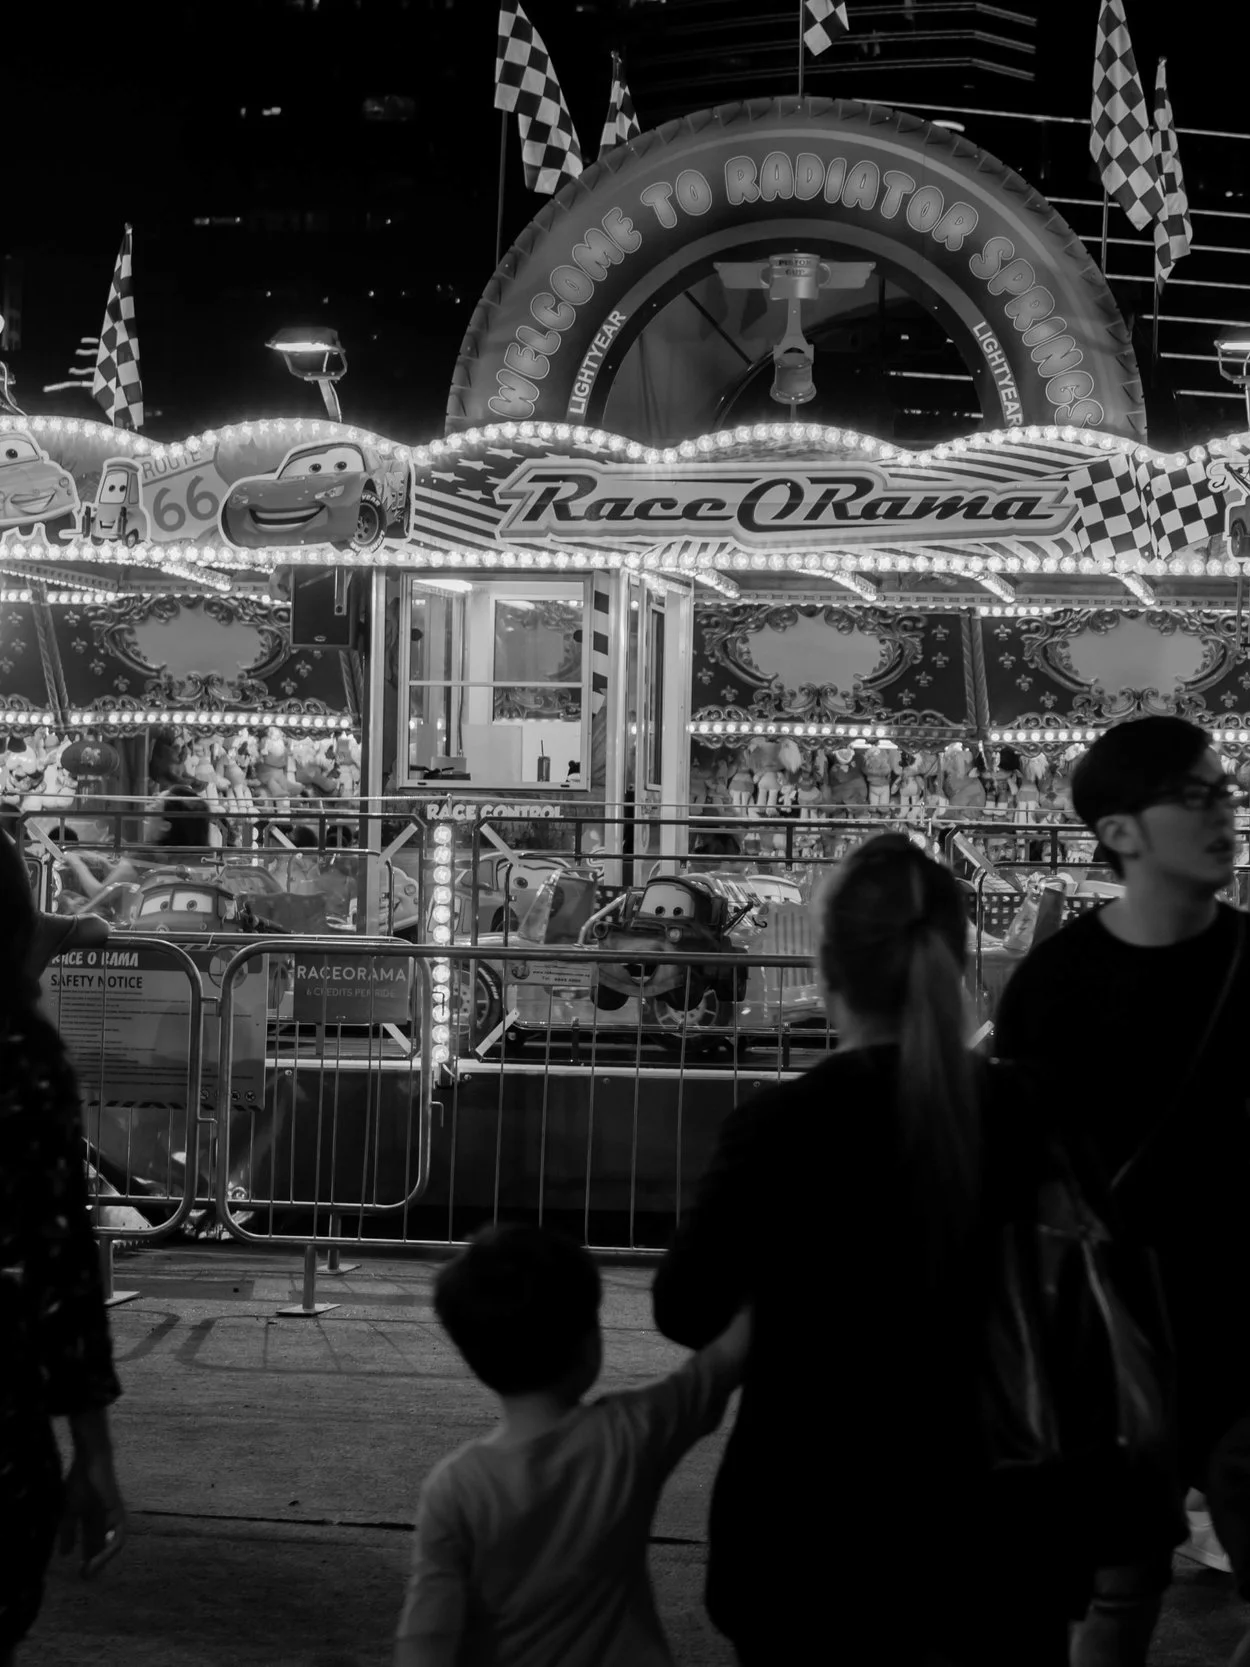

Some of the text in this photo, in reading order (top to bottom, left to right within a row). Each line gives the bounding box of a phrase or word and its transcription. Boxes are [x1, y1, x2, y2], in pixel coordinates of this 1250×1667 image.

[488, 152, 1104, 428] WELCOME TO RADIATOR SPRINGS
[569, 309, 627, 415] LIGHTYEAR
[973, 321, 1024, 427] LIGHTYEAR
[153, 475, 219, 532] 66
[427, 804, 565, 820] RACE CONTROL
[87, 951, 97, 965] O
[297, 965, 406, 982] RACEORAMA
[51, 974, 143, 989] SAFETY NOTICE
